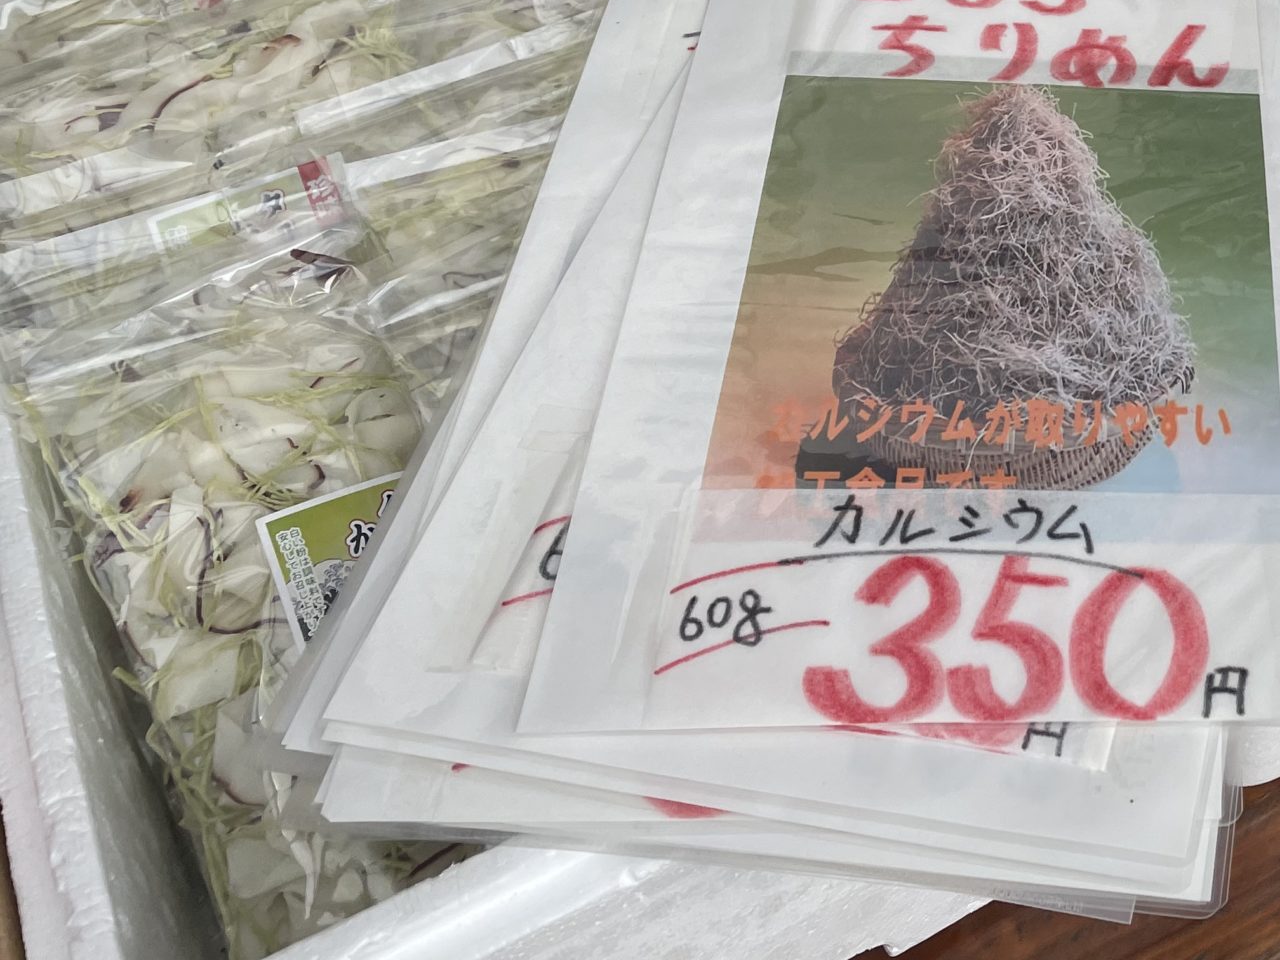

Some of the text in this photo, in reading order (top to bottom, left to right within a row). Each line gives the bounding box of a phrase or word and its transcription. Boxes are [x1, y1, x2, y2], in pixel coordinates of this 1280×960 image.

[871, 16, 1230, 89] ちりめん
[813, 493, 1096, 555] カルシウム
[679, 588, 772, 648] 60g
